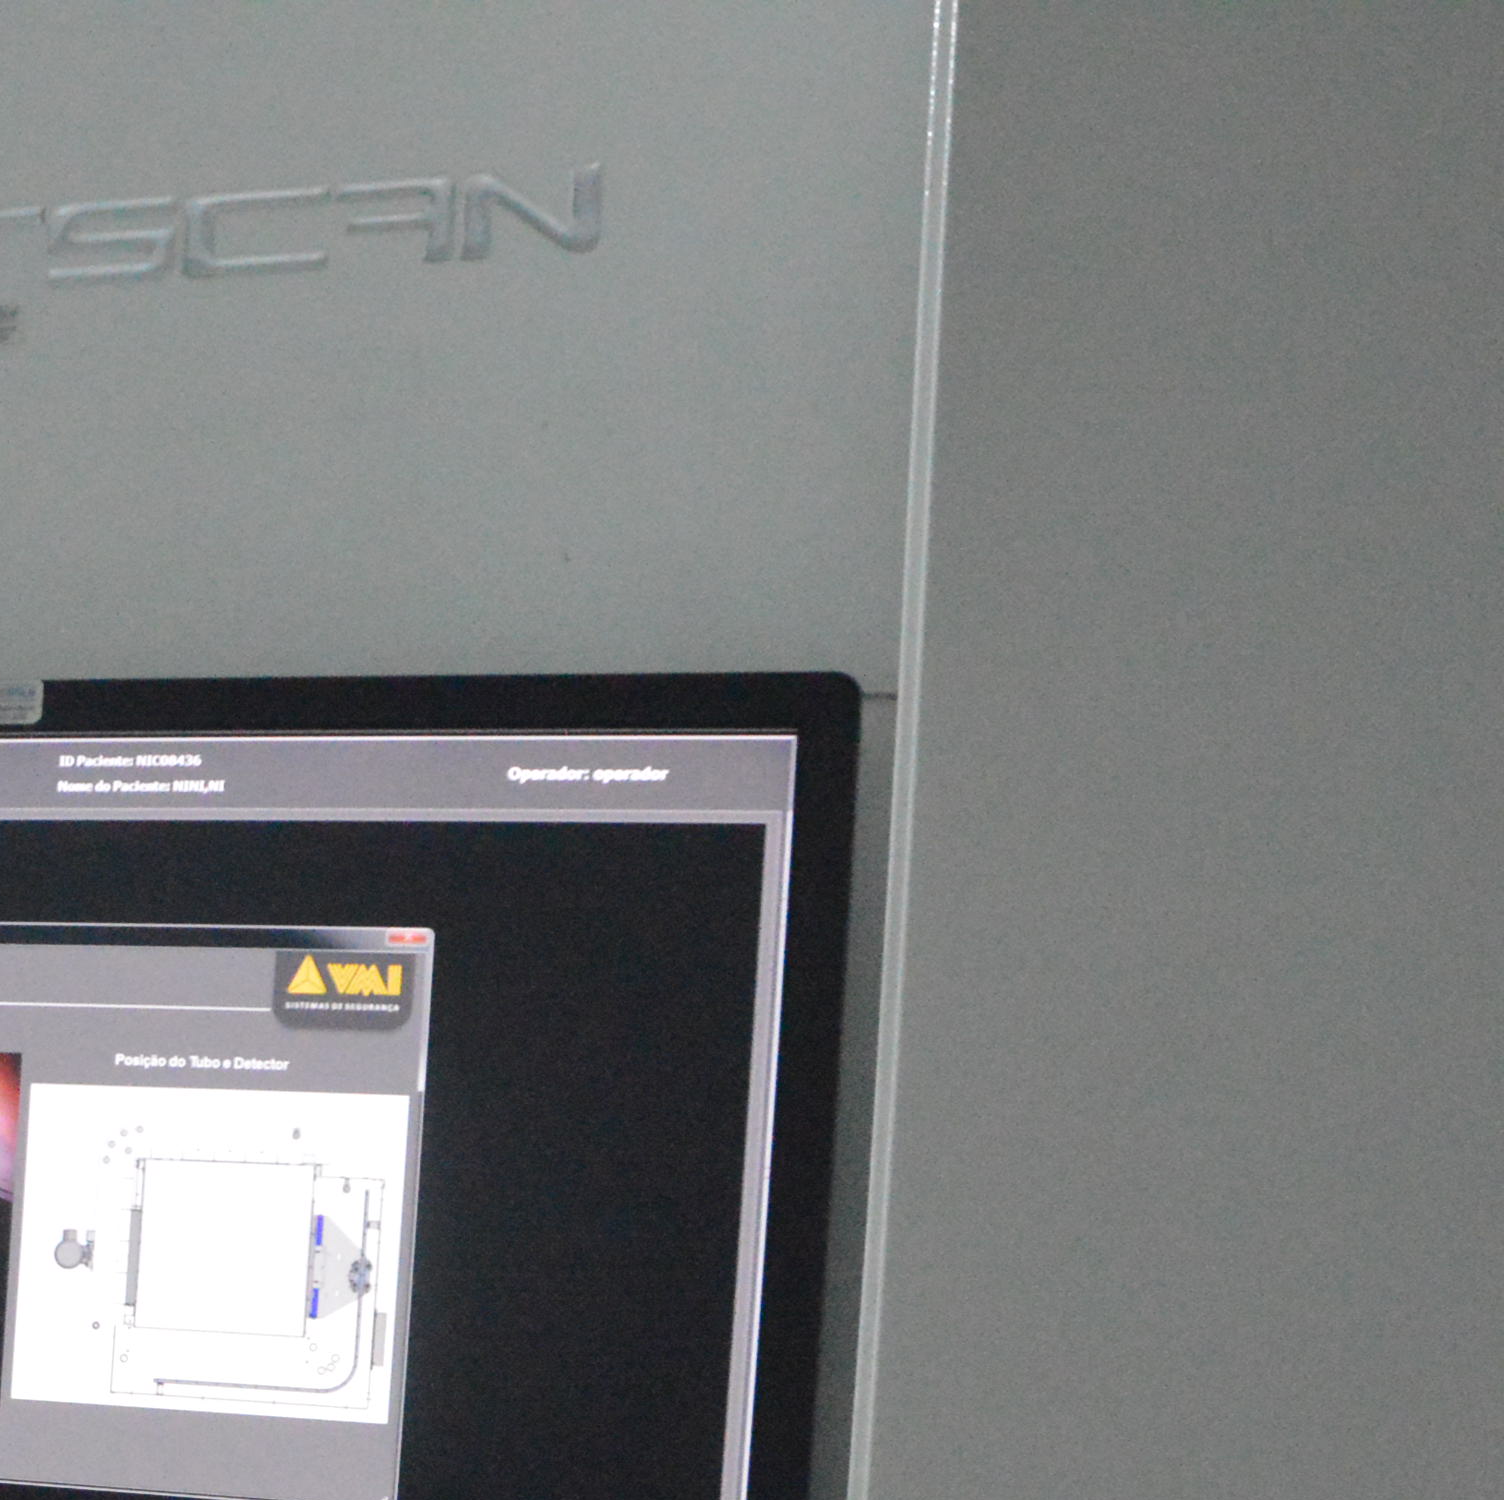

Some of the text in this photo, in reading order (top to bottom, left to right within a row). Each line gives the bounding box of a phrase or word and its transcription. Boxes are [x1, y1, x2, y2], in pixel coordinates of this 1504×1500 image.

[58, 755, 74, 767] ID
[76, 755, 134, 767] Paciente:
[507, 766, 669, 784] Operador: operador
[57, 780, 93, 793] Nome
[94, 780, 111, 793] do
[112, 780, 170, 793] Paciente:
[285, 1001, 330, 1010] SISTEMAS
[345, 1003, 400, 1013] SEGURANÇA
[115, 1053, 290, 1071] Posição do Tubo e Detector
